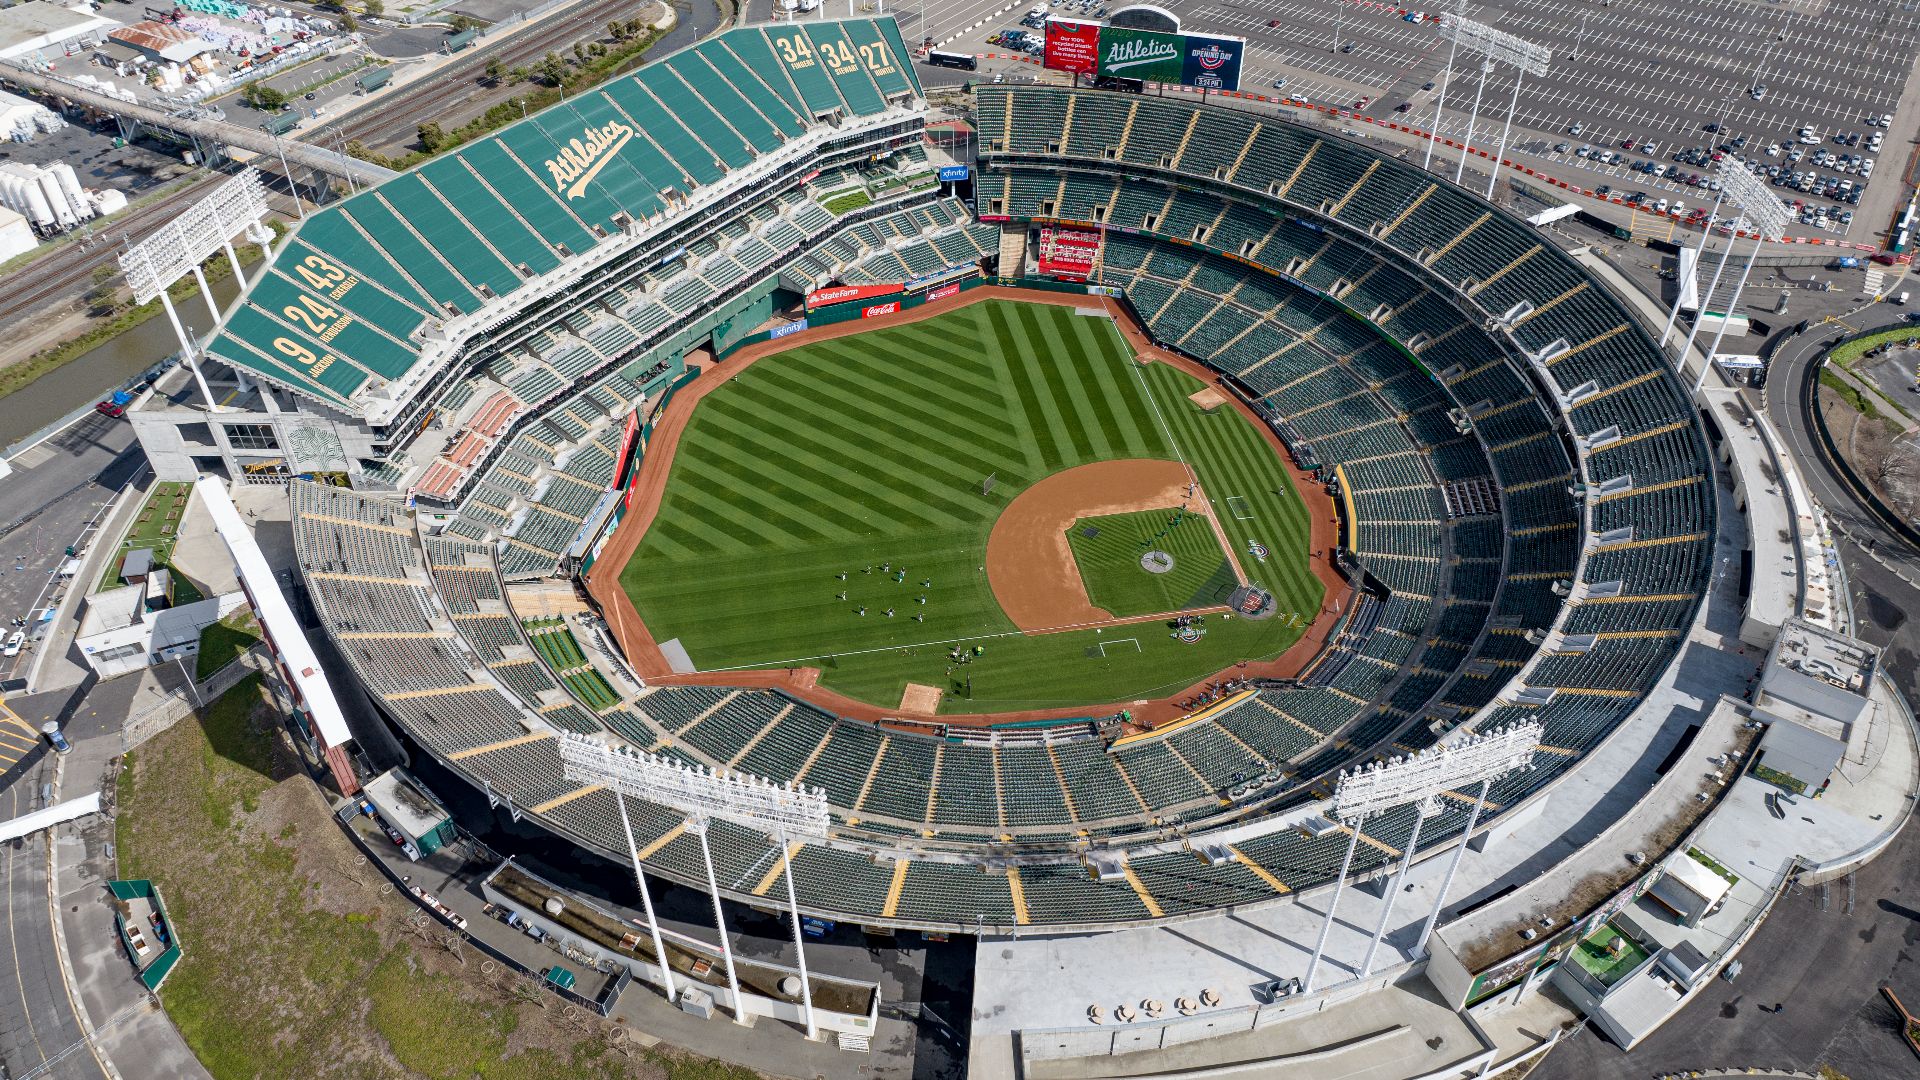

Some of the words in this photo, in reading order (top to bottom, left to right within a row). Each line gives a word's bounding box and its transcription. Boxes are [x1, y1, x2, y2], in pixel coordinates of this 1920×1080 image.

[776, 35, 811, 63] 34
[821, 40, 855, 68] 34
[860, 42, 890, 70] 27
[1104, 39, 1177, 64] Athletics
[1191, 49, 1219, 59] OPENING
[1219, 52, 1232, 60] DAY
[791, 59, 815, 71] FINGERS
[835, 64, 859, 76] STEWART
[874, 66, 896, 77] HUNTER
[545, 120, 633, 196] Athletics
[942, 169, 966, 178] xfinity
[295, 255, 345, 289] 43
[820, 291, 840, 301] State
[840, 288, 859, 298] Farm
[283, 294, 338, 334] 24
[867, 302, 896, 317] Coca-Cola
[319, 313, 354, 344] HENDERSON
[776, 322, 802, 337] xfinity
[273, 337, 317, 365] 9
[308, 353, 337, 378] JACKSON
